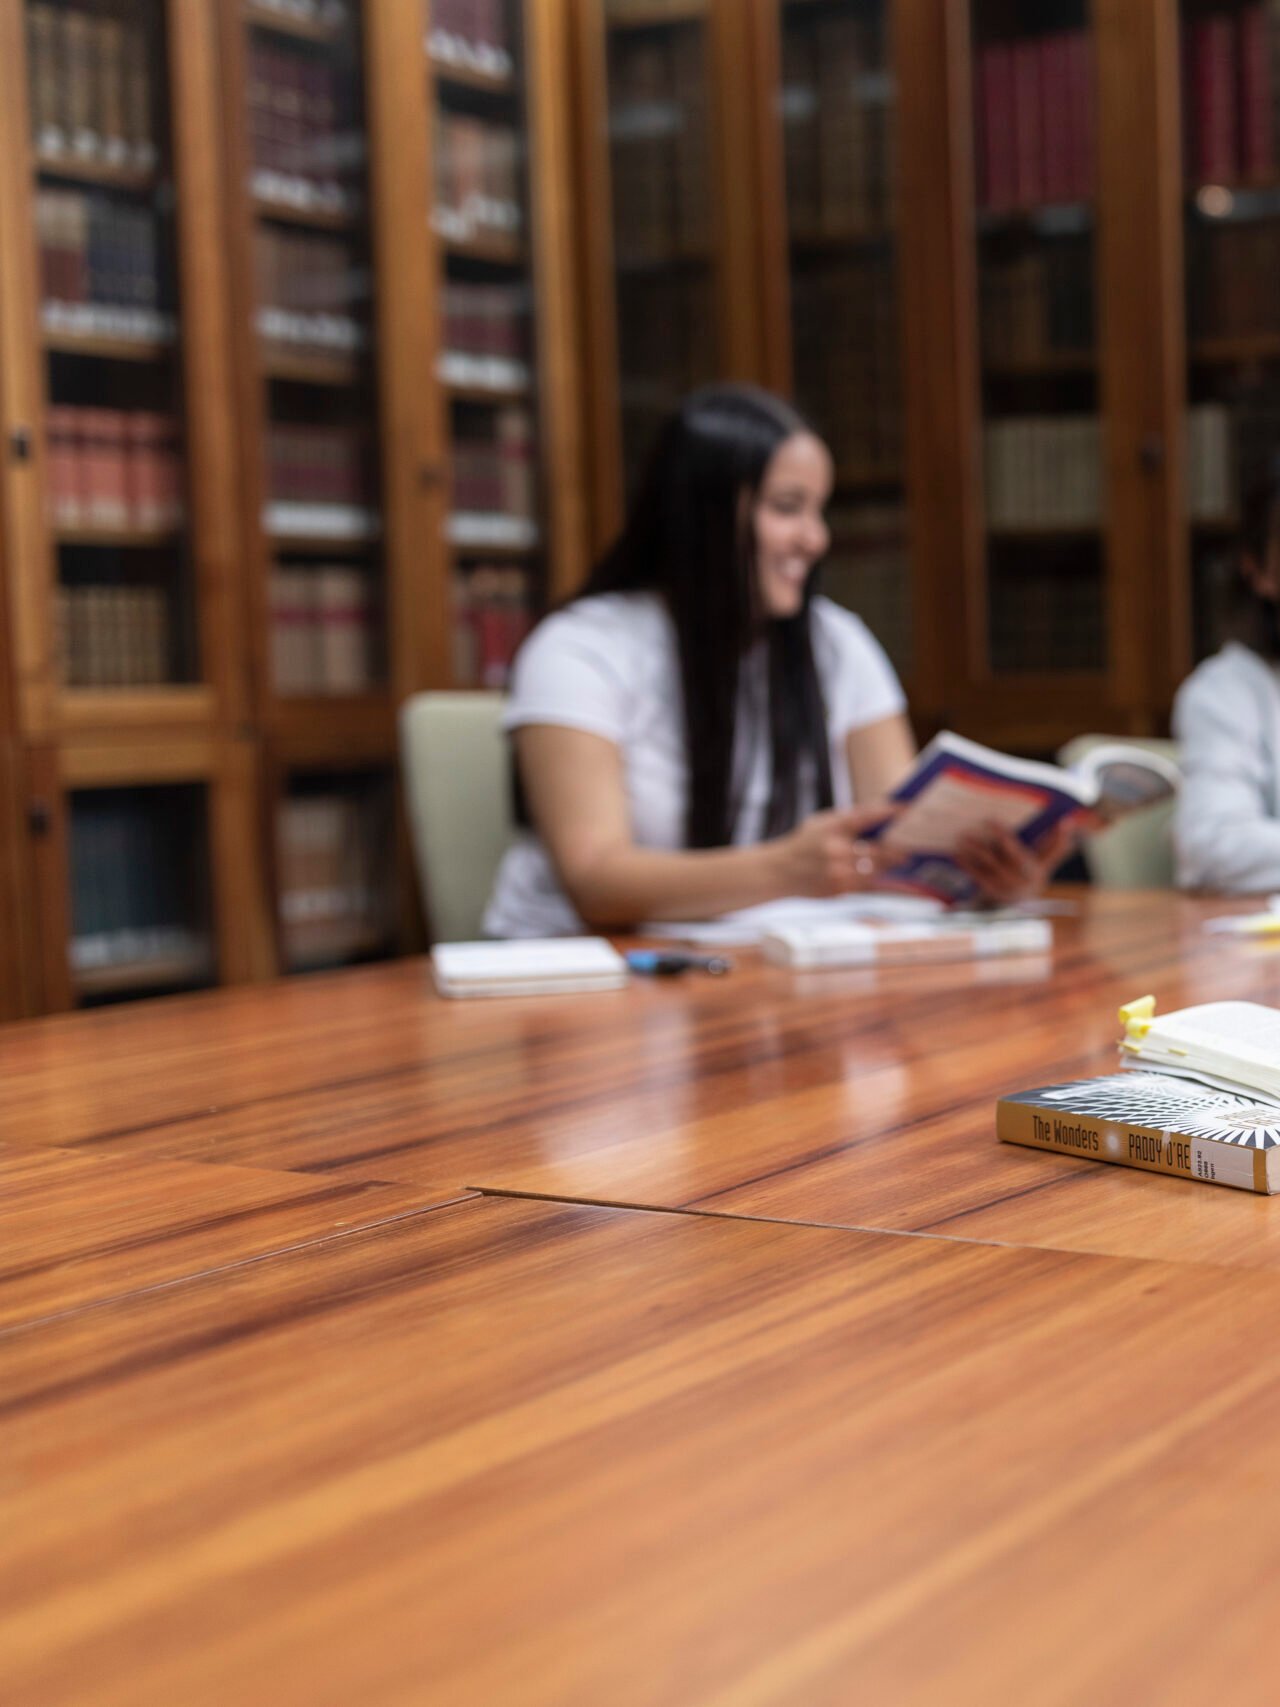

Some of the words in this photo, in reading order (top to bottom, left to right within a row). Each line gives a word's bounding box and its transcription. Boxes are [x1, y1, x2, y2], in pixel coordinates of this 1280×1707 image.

[1032, 1114, 1051, 1142] The
[1053, 1118, 1099, 1152] Wonders
[1128, 1133, 1162, 1165] PADDY
[1166, 1140, 1191, 1170] O'RE
